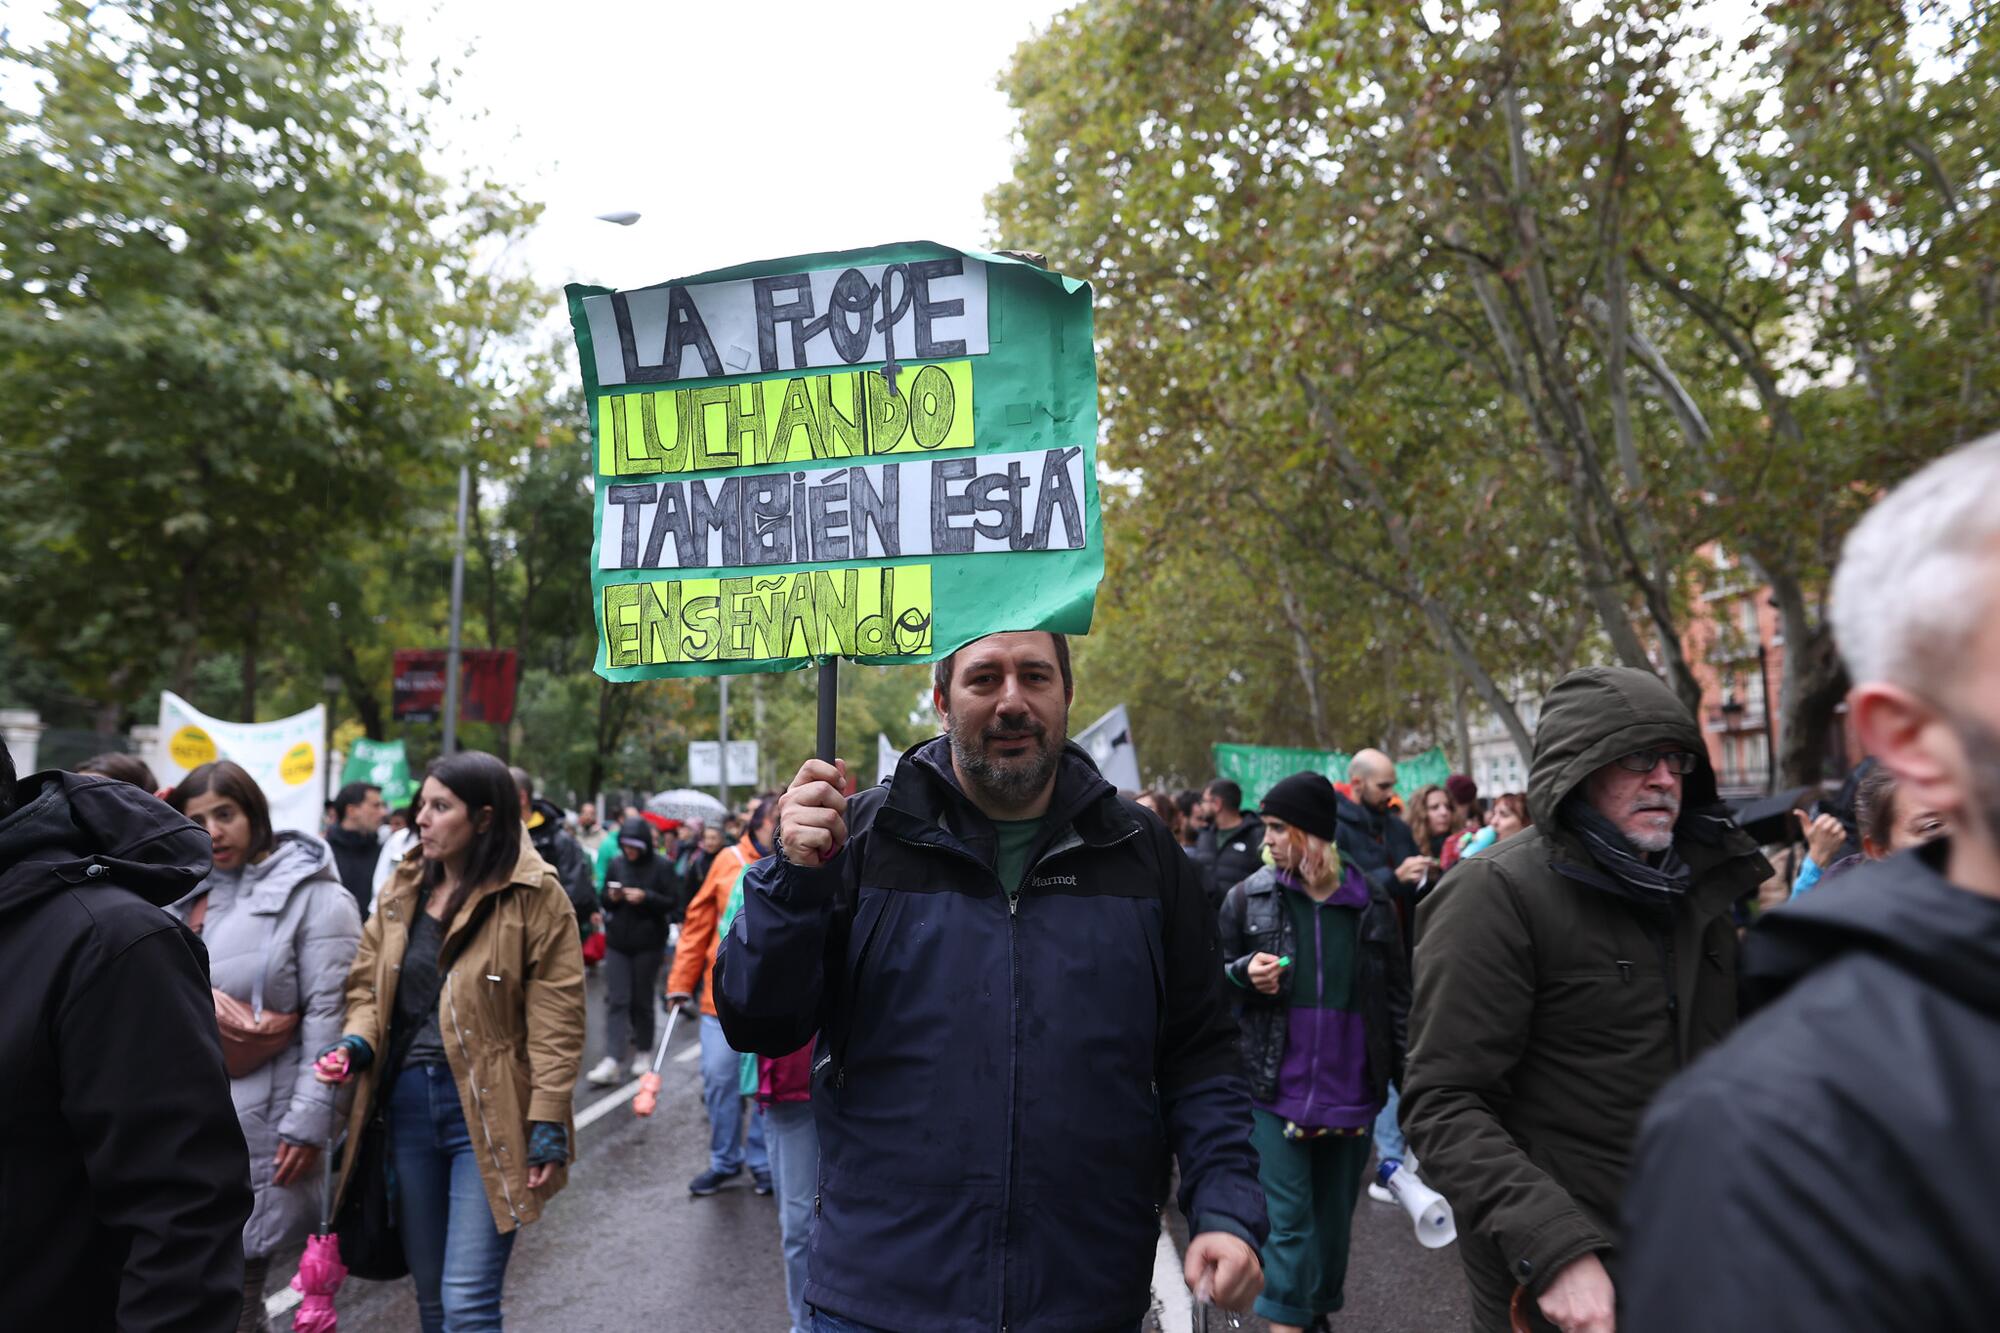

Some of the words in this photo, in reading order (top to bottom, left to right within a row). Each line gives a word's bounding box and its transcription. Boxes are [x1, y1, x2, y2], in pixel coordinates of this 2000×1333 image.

[610, 286, 724, 383] LA
[610, 364, 956, 476] LUCHANDO
[1031, 874, 1078, 887] Marmot
